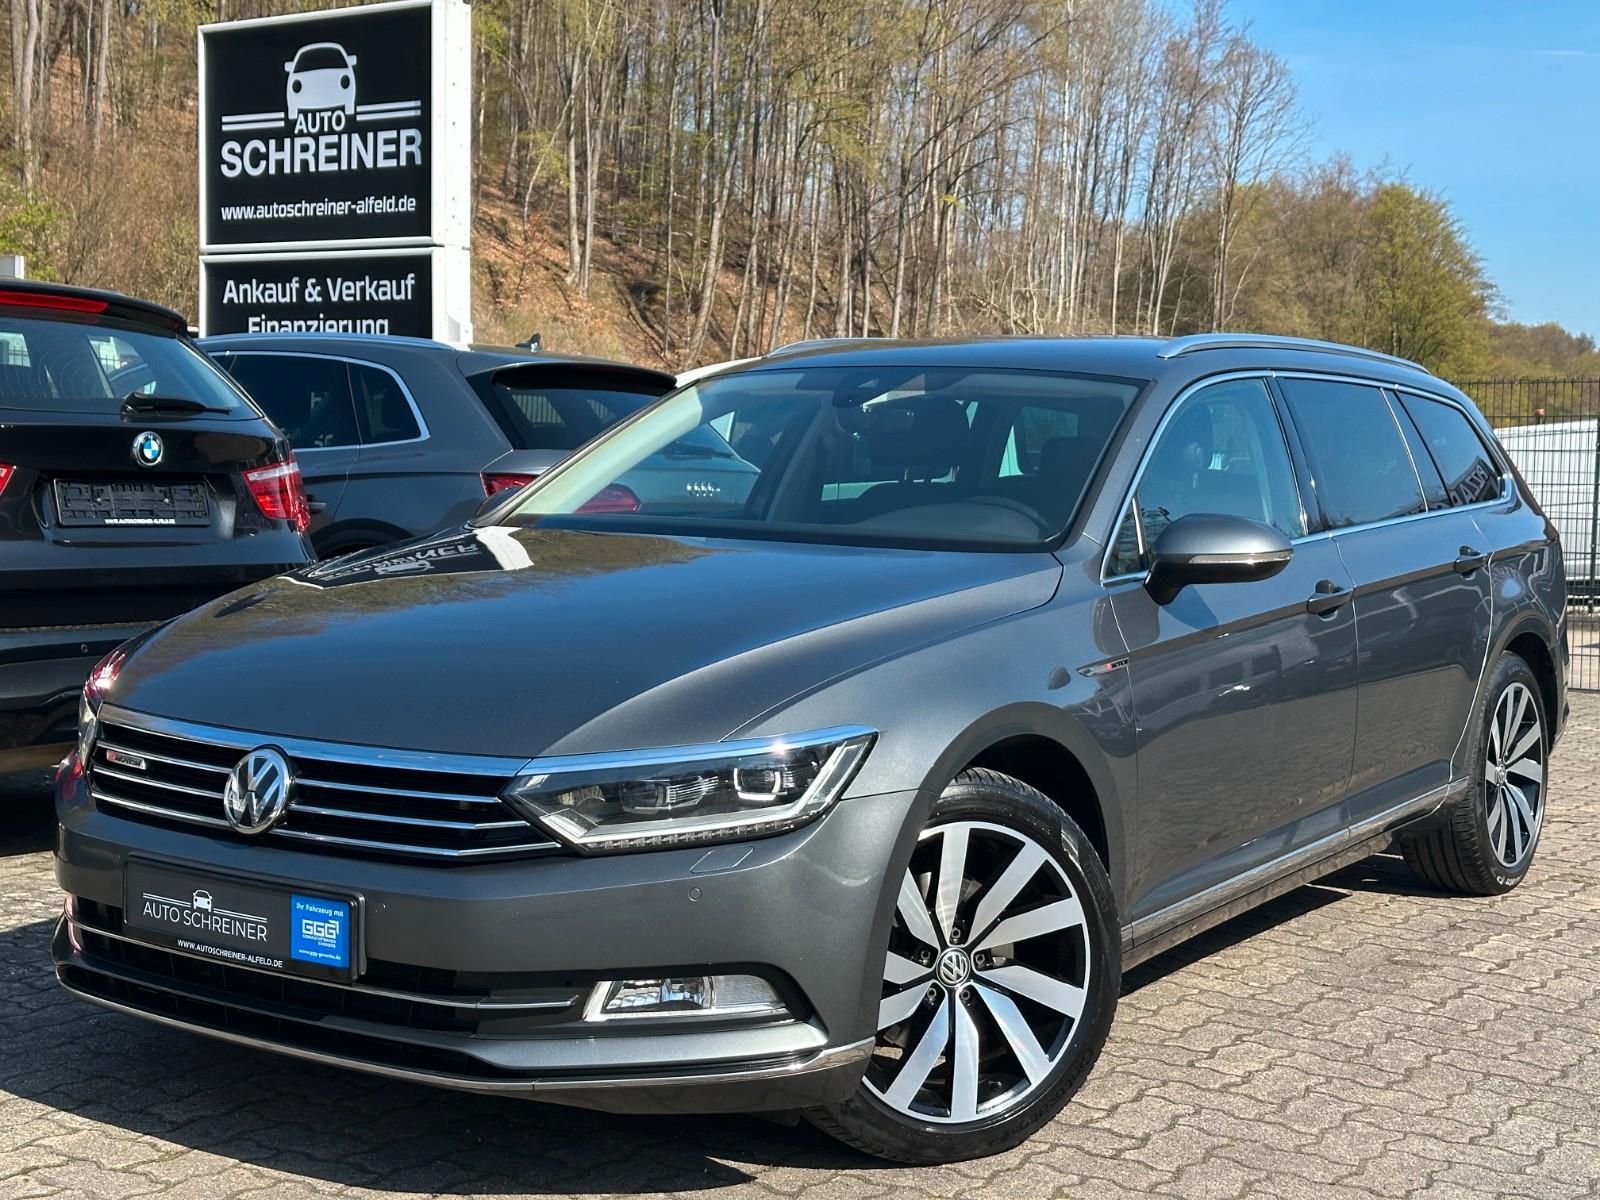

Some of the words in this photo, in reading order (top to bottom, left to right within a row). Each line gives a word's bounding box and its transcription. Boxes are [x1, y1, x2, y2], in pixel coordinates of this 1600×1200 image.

[294, 110, 346, 134] AUTO
[220, 128, 422, 178] SCHREINER
[221, 194, 416, 220] www.autoschreiner-alfeld.de
[222, 277, 299, 304] Ankauf
[304, 278, 322, 302] &
[326, 273, 415, 302] Verkauf
[142, 901, 180, 923] AUTO
[183, 910, 268, 942] SCHREINER
[305, 903, 333, 917] Fahrzeug
[302, 919, 337, 939] GGG
[177, 939, 283, 968] WWW.AUTOSCHREINER-ALFELD.DE
